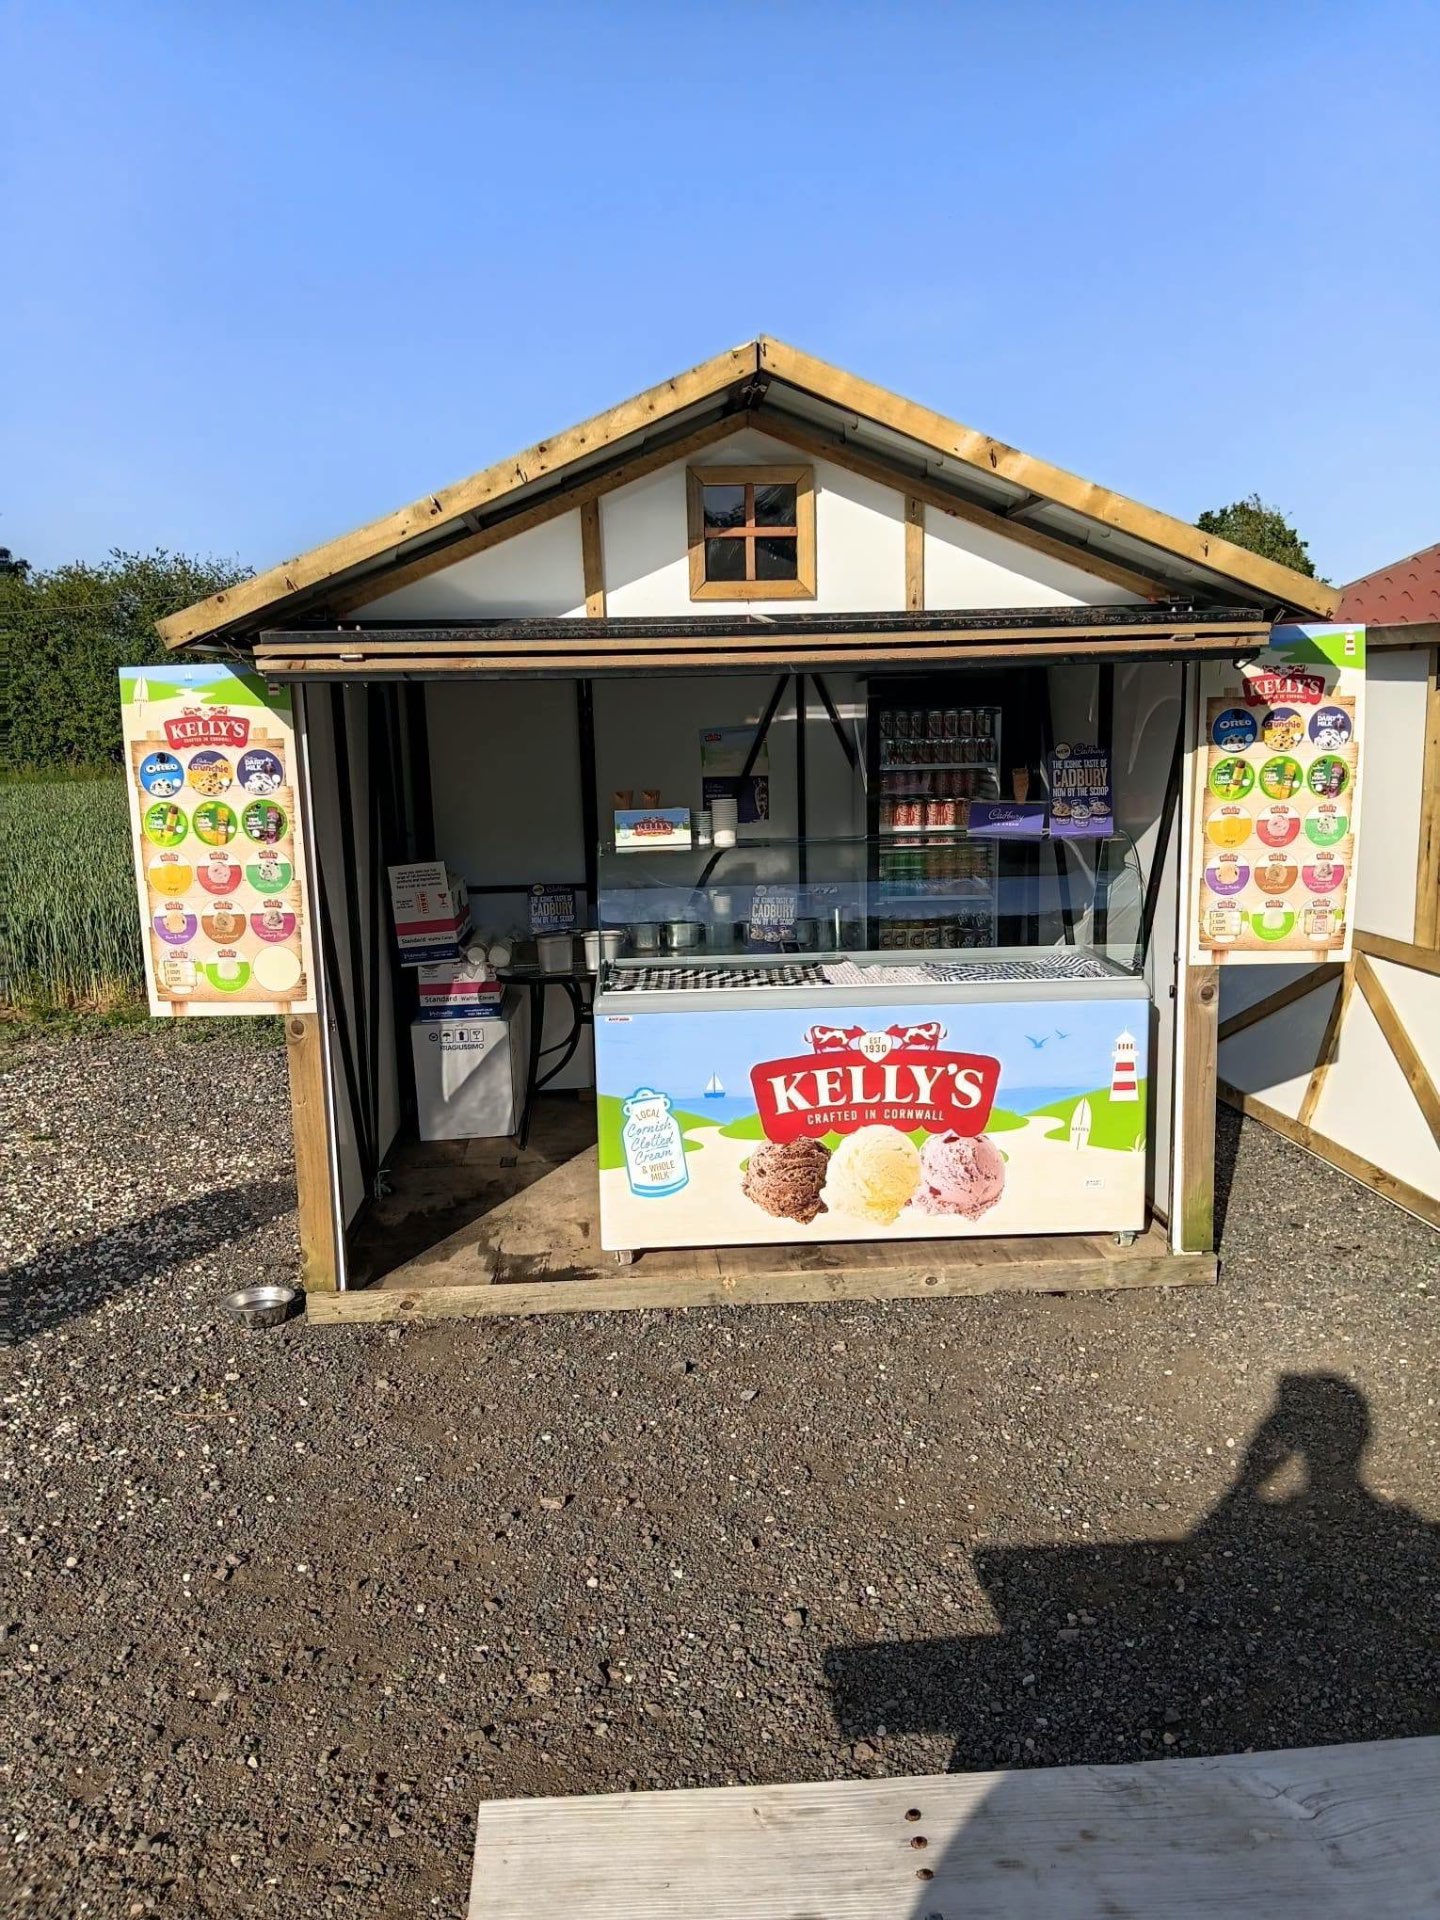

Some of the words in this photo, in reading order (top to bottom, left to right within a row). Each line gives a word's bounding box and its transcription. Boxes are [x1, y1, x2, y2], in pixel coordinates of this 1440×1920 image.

[1250, 679, 1320, 695] KELLY'S
[170, 721, 245, 740] KELLY'S
[1220, 720, 1252, 729] OREO
[1074, 743, 1105, 756] Cadbury
[146, 763, 177, 773] OREO
[1052, 760, 1063, 768] THE
[1064, 760, 1082, 768] ICONIC
[1083, 760, 1100, 768] TASTE
[1100, 759, 1107, 768] OF
[1053, 768, 1107, 787] CADBURY
[1052, 788, 1066, 797] NOW
[1068, 788, 1075, 797] BY
[1077, 787, 1088, 796] THE
[1089, 786, 1109, 796] SCOOP
[988, 808, 1025, 822] Cadbury
[637, 822, 672, 832] KELLY'S
[531, 901, 573, 916] CADBURY
[752, 903, 795, 918] CADBURY
[425, 995, 457, 1003] Standard
[869, 1037, 881, 1045] EST
[864, 1044, 887, 1053] 1930
[767, 1062, 984, 1116] KELLY'S
[635, 1109, 659, 1121] LOCAL
[807, 1110, 857, 1125] CRAFTED
[865, 1109, 877, 1120] IN
[884, 1108, 944, 1121] CORNWALL
[627, 1117, 672, 1137] Cornish
[631, 1131, 674, 1151] Clotted
[635, 1150, 672, 1165] Cream
[641, 1165, 648, 1174] &
[649, 1160, 675, 1172] WHOLE
[651, 1171, 670, 1181] MILK
